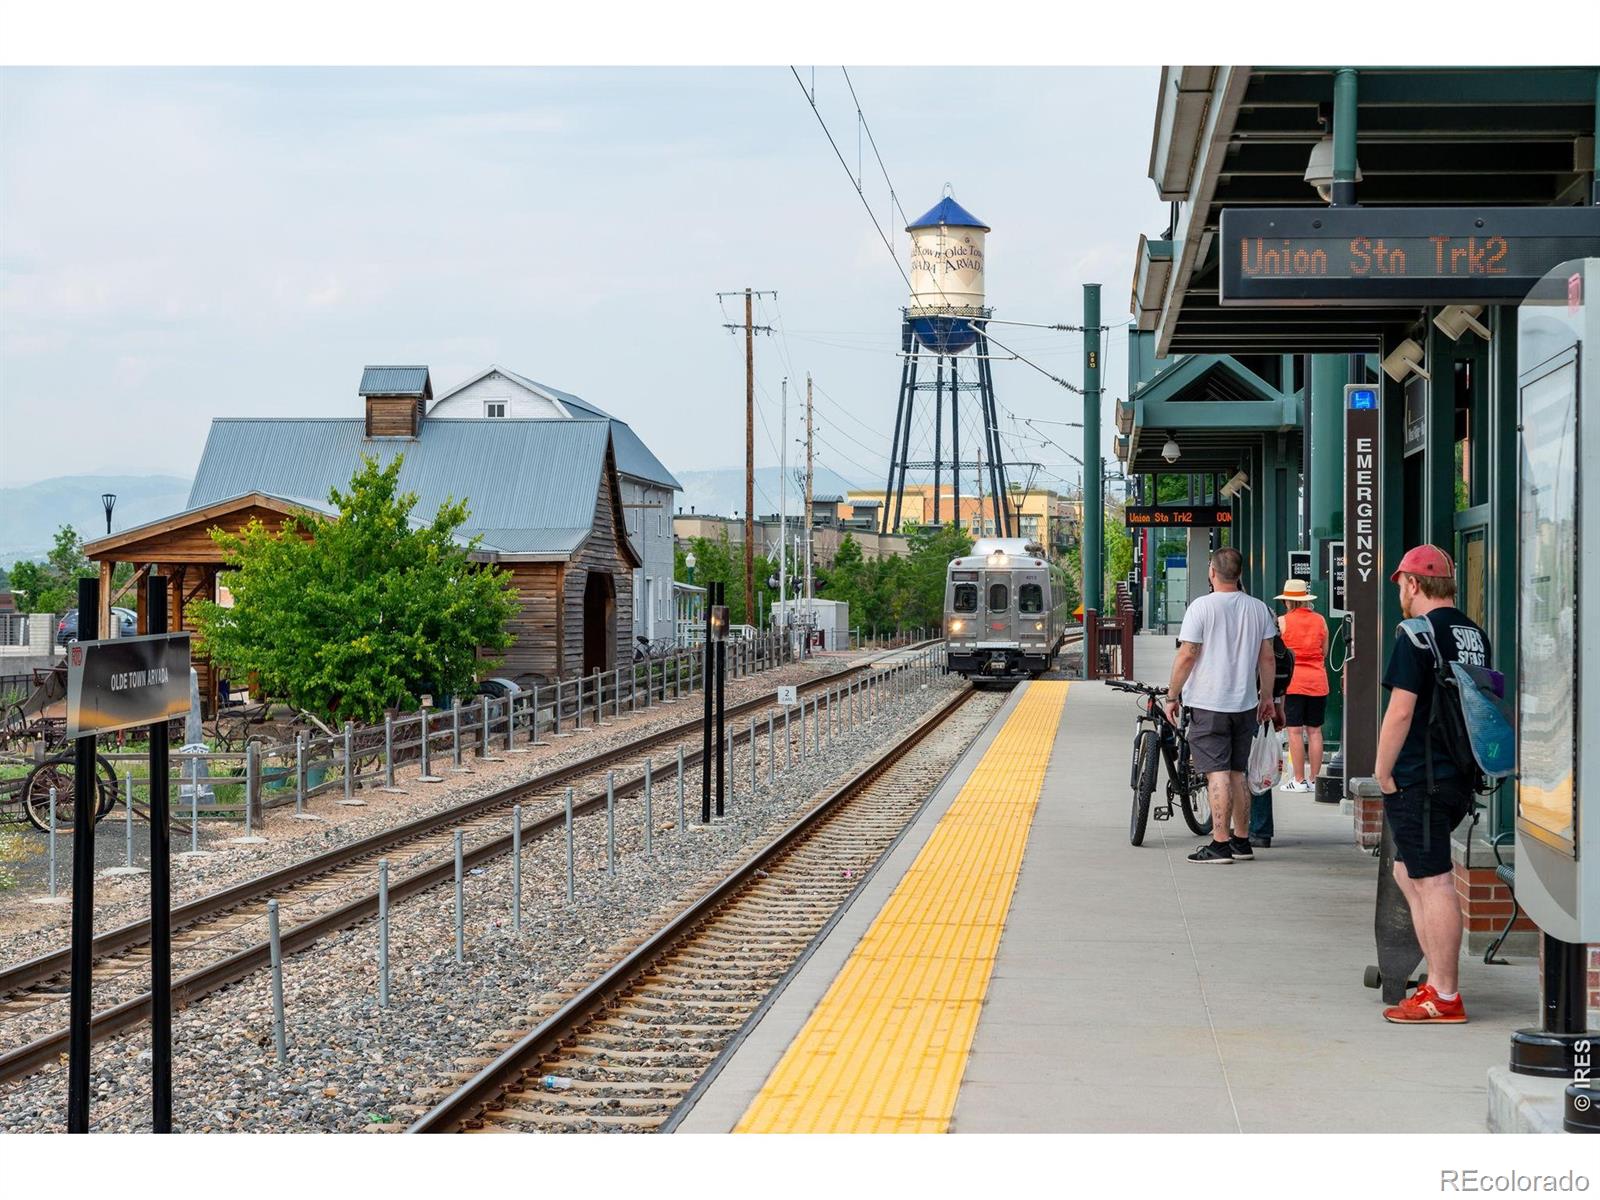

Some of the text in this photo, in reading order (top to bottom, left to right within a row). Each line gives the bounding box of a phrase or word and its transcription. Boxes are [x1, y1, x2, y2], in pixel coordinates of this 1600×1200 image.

[944, 245, 967, 259] Olde
[1240, 235, 1510, 275] Union Stn Trk2
[1129, 512, 1151, 523] Union
[1154, 512, 1169, 523] Stn
[1173, 512, 1193, 523] Trk2
[1356, 438, 1373, 582] EMERGENCY
[1452, 628, 1484, 653] SUBS
[111, 667, 169, 691] OLDE TOWN ARVADA
